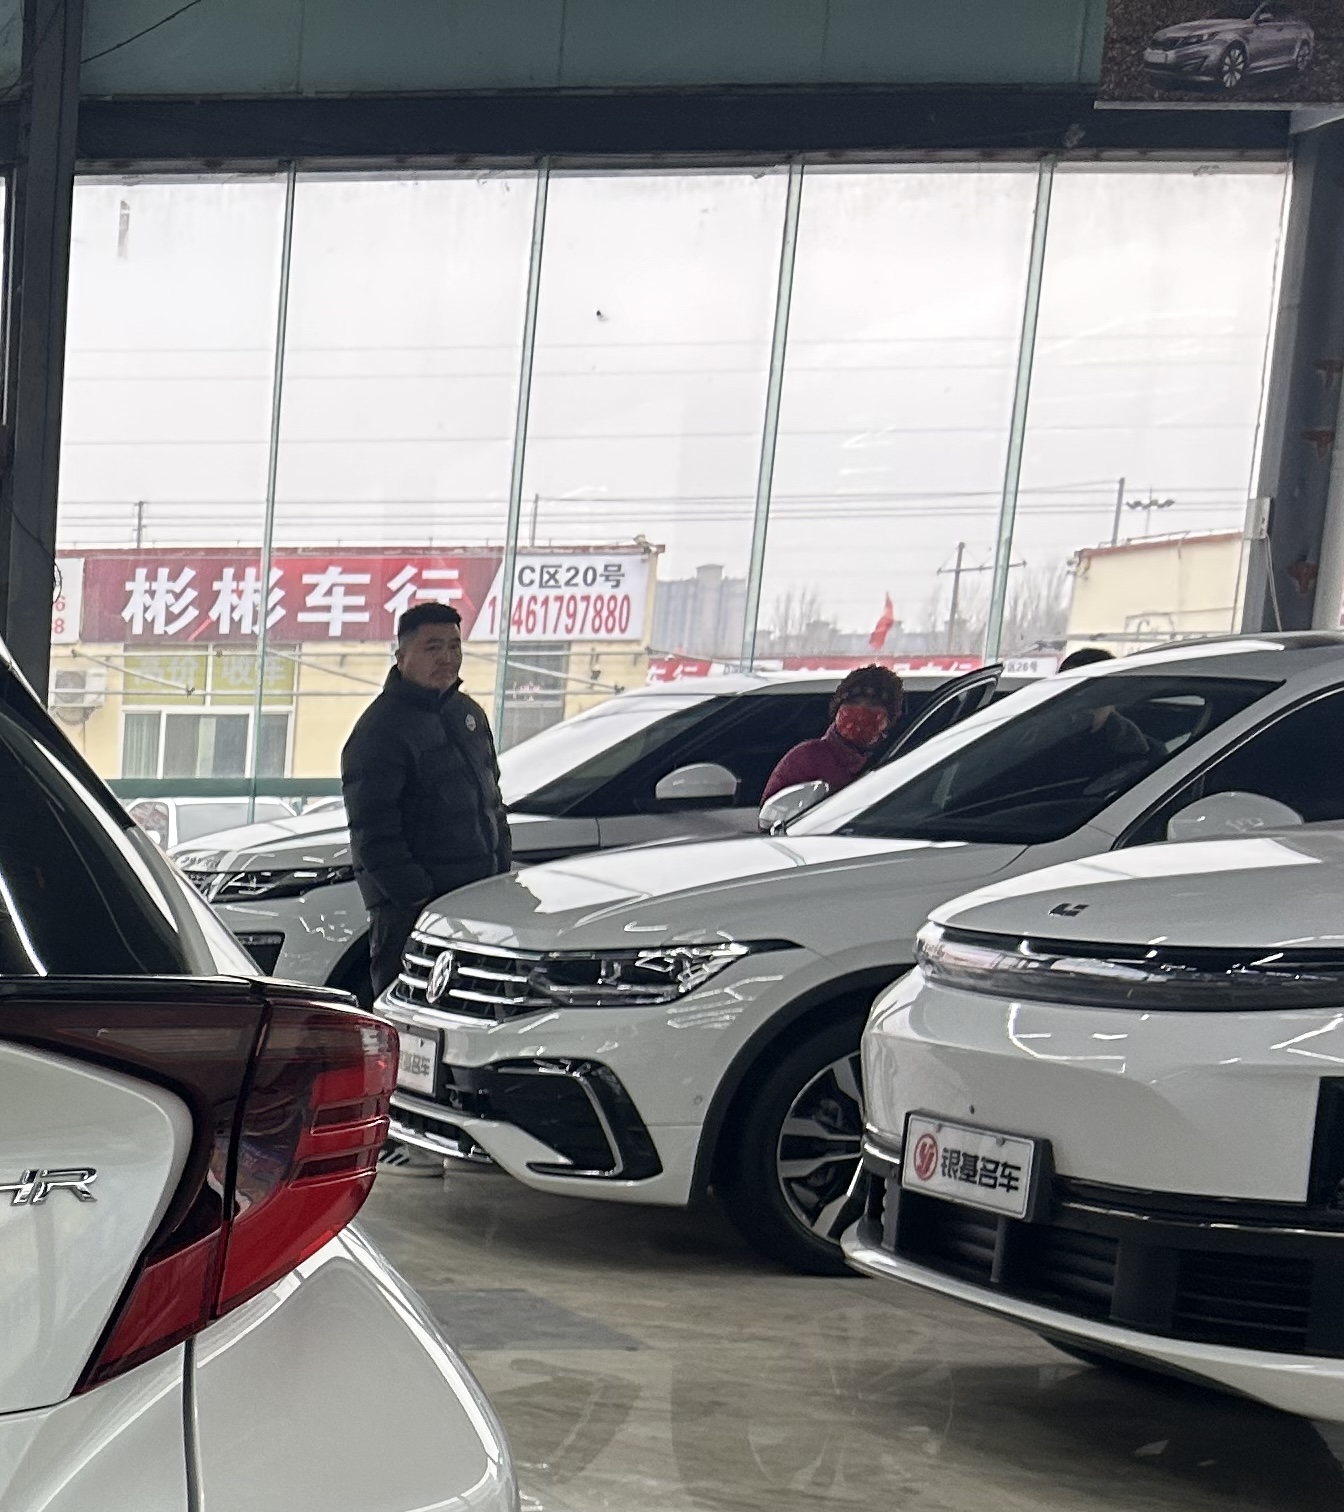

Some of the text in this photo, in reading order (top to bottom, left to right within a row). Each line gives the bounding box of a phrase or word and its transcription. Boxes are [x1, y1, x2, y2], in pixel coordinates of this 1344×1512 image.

[517, 563, 626, 589] C区20号
[121, 565, 462, 637] 彬彬车行
[488, 594, 632, 635] 1461797880
[940, 1147, 1022, 1193] 银基名车
